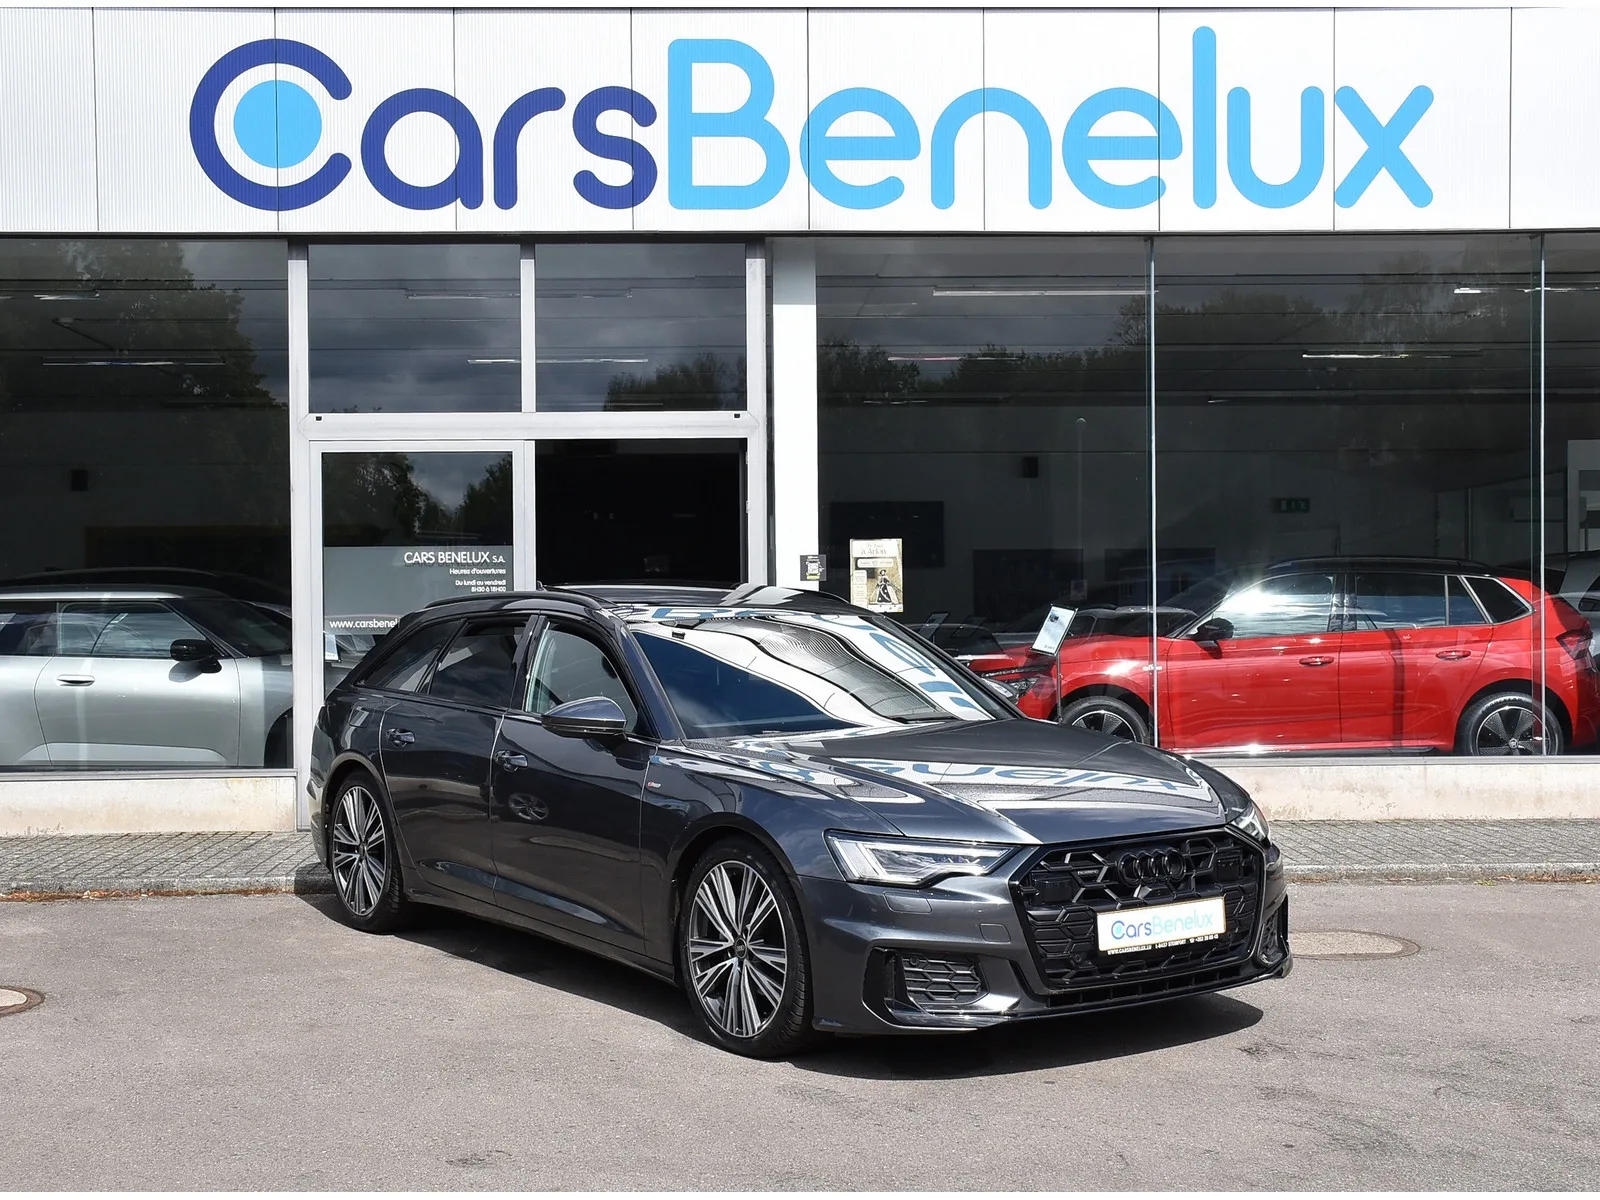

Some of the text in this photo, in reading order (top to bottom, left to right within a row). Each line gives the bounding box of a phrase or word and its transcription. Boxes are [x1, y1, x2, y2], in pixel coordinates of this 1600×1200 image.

[189, 25, 1435, 212] CarsBenelux
[403, 551, 435, 564] CARS
[438, 551, 490, 564] BENELUX
[329, 618, 399, 629] www.carsbenel
[1110, 908, 1214, 940] CarsBenelux
